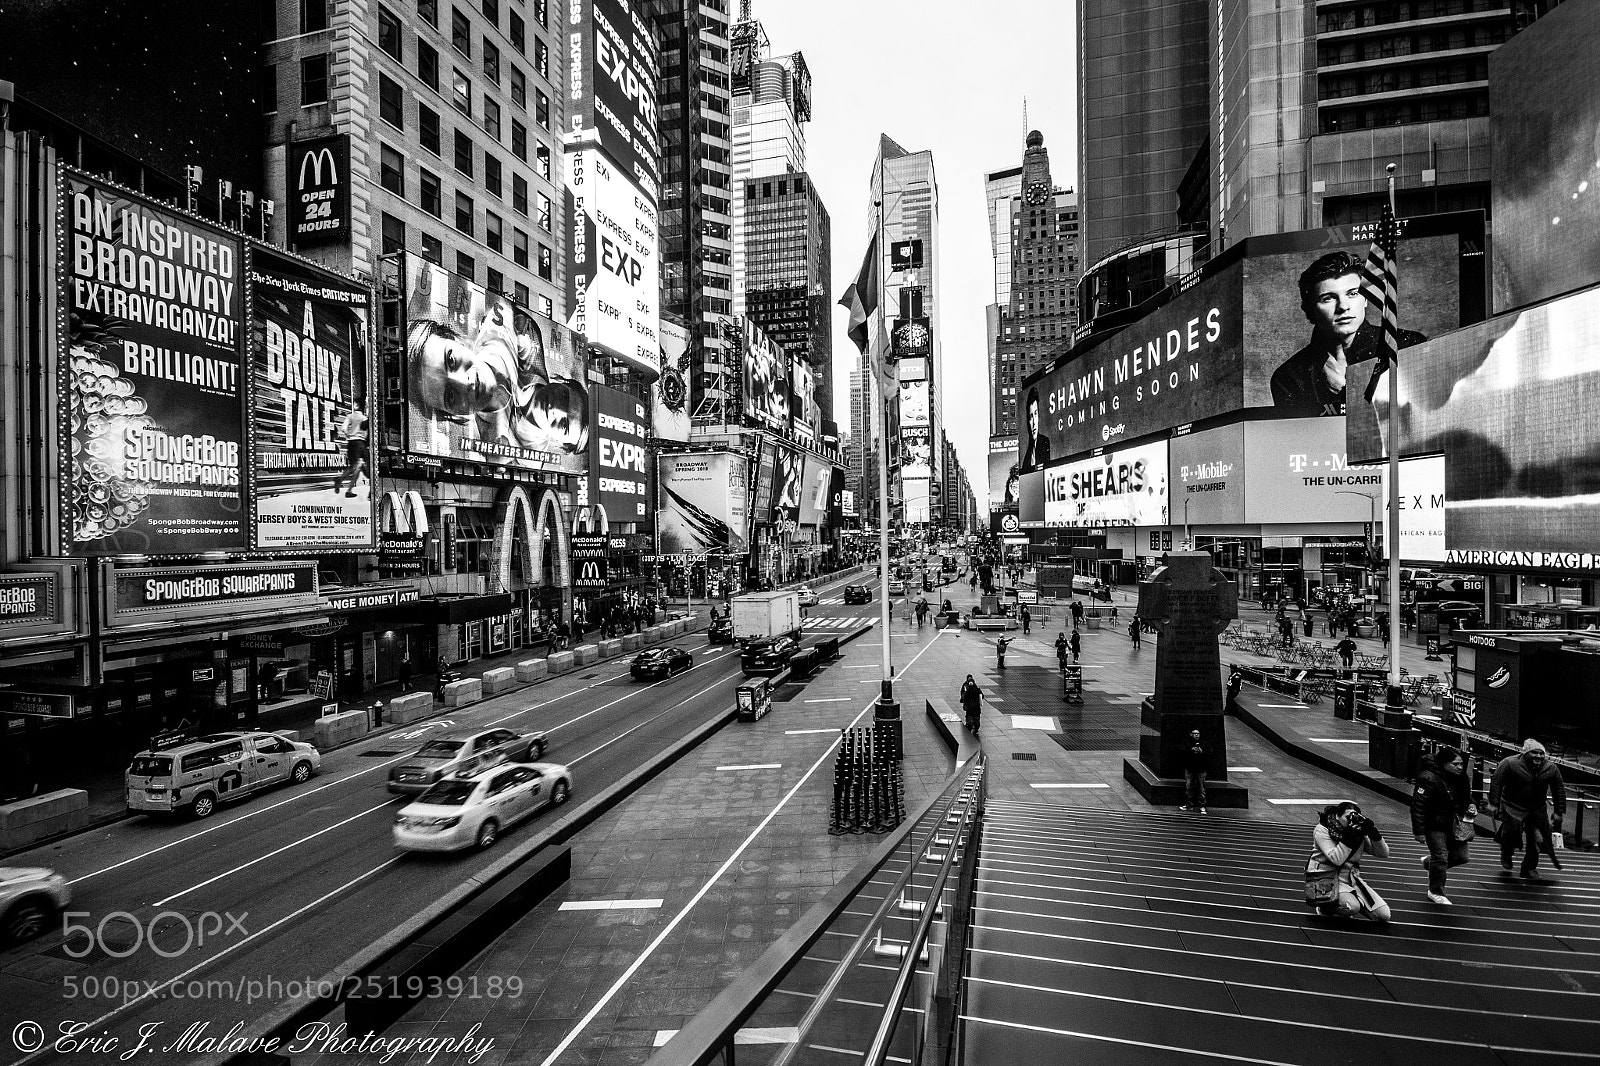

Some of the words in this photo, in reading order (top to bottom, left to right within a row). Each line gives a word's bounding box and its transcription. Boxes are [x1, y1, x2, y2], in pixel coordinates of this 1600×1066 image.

[593, 3, 630, 59] EXPRESS
[570, 33, 583, 100] EXPRESS
[595, 94, 631, 143] EXPRESS
[301, 189, 335, 203] OPEN
[305, 203, 331, 220] 24
[298, 218, 340, 233] HOURS
[573, 197, 586, 264] EXPRESS
[597, 209, 632, 246] EXPRESS
[121, 208, 234, 280] INSPIRED
[601, 234, 642, 288] EXP
[74, 233, 234, 316] BROADWAY
[1180, 267, 1203, 286] MARRIOTT
[251, 271, 266, 283] The
[265, 274, 282, 287] New
[282, 278, 301, 292] York
[300, 282, 321, 297] Times
[351, 292, 367, 304] PICK
[1180, 276, 1201, 293] MARQUIS
[303, 299, 316, 340] A
[894, 346, 929, 354] TOSHIBA
[266, 319, 342, 402] BRONX
[1048, 366, 1105, 414] SHAWN
[1114, 307, 1221, 385] MENDES
[1058, 395, 1120, 431] COMING
[1136, 362, 1199, 402] SOON
[281, 387, 338, 451] TALE
[598, 412, 635, 435] EXPRESS
[902, 427, 929, 438] BUSCH
[1109, 423, 1125, 436] Spotify
[461, 438, 470, 451] IN
[474, 441, 521, 458] THEATERS
[522, 449, 549, 464] MARCH
[989, 440, 1003, 448] THE
[304, 453, 318, 468] NEW
[318, 453, 328, 468] HIT
[599, 477, 636, 495] EXPRESS
[1071, 460, 1147, 500] SHEARS
[1186, 484, 1196, 493] THE
[1195, 481, 1226, 493] UN-CARRIER
[1303, 476, 1325, 486] THE
[173, 488, 203, 498] MUSICAL
[257, 514, 286, 524] JERSEY
[287, 515, 307, 524] BOYS
[307, 516, 314, 524] &
[313, 515, 333, 524] WEST
[333, 516, 349, 524] SIDE
[297, 505, 335, 515] COMBINATION
[335, 506, 343, 514] OF
[571, 536, 607, 544] McDonald's
[1445, 549, 1535, 567] AMERICAN
[1541, 551, 1600, 570] EAGLE
[146, 576, 220, 601] SPONGEBOB
[221, 572, 296, 595] SQUAREPANTS
[1463, 581, 1481, 590] BIG
[358, 594, 395, 607] MONEY
[399, 591, 419, 603] ATM
[240, 640, 282, 649] EXCHANGE
[245, 633, 273, 641] MONEY
[1469, 635, 1496, 648] HOTDOGS
